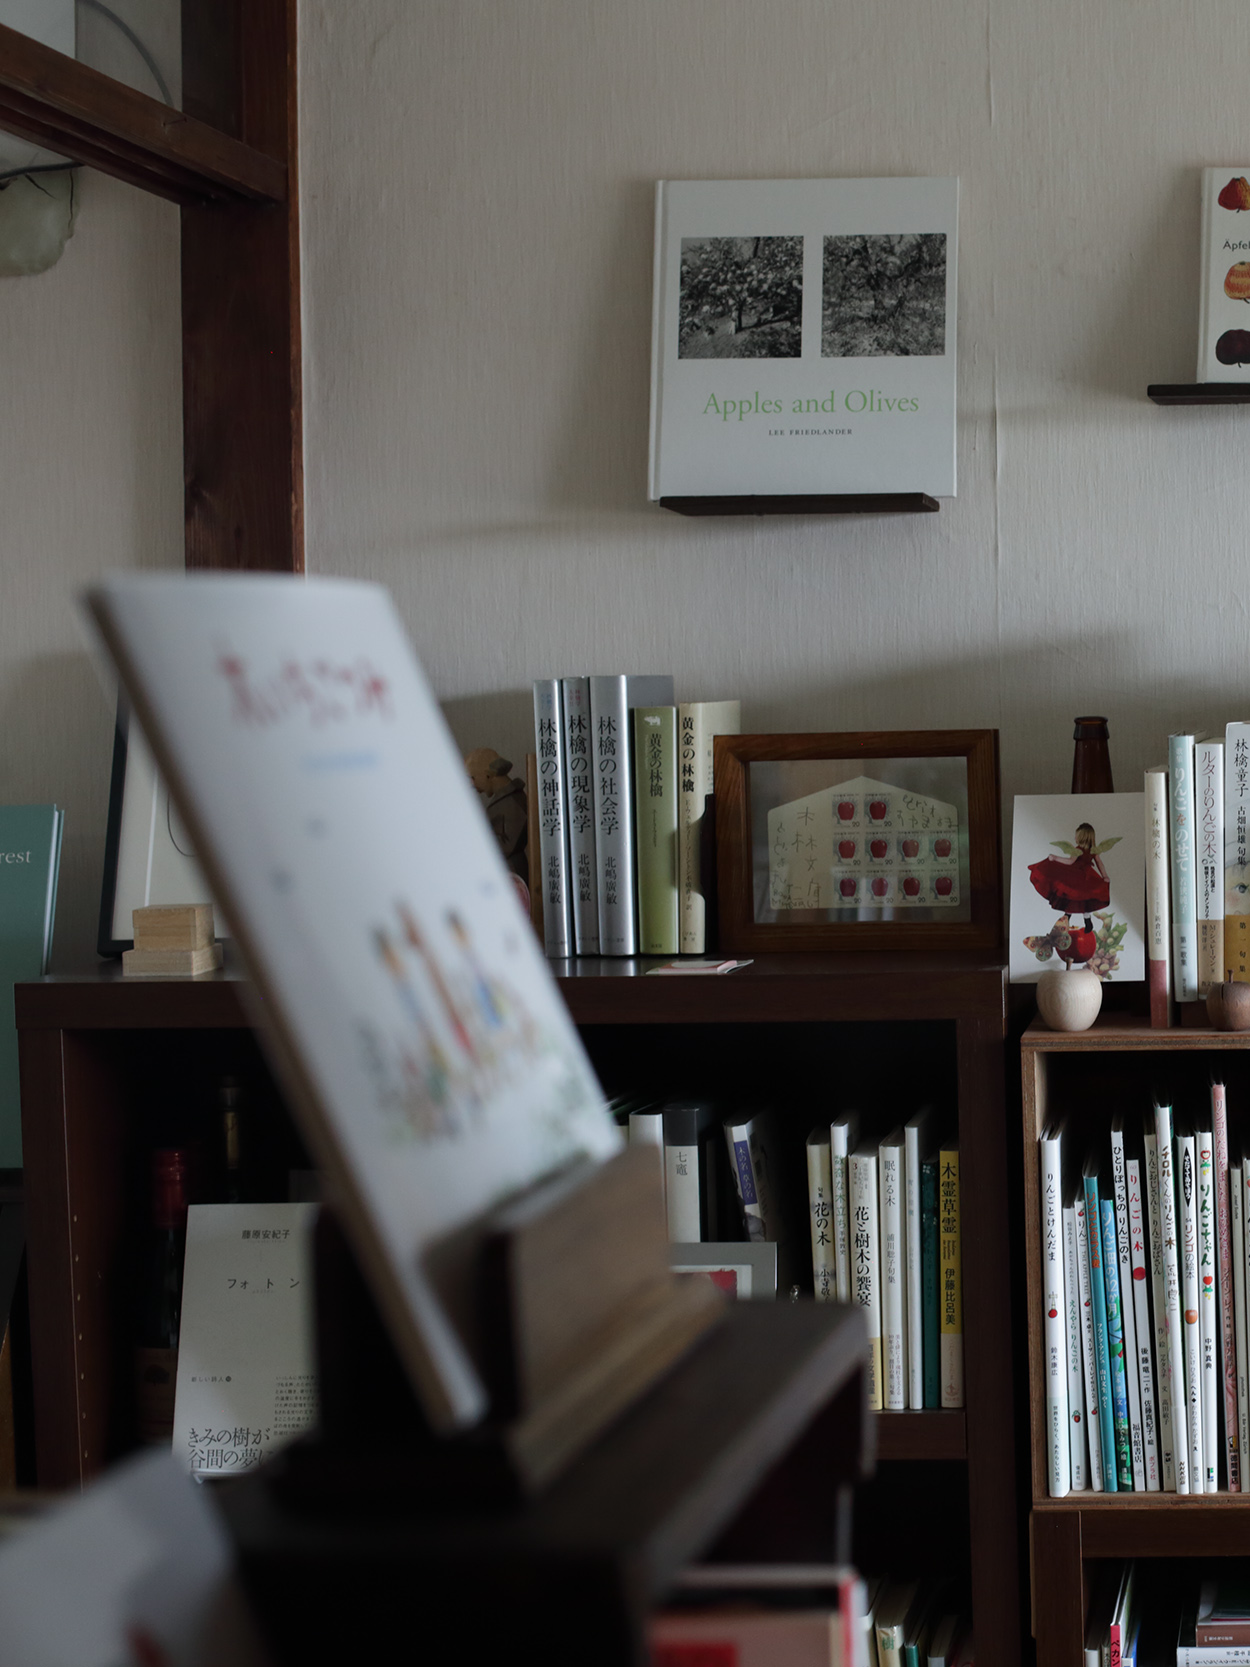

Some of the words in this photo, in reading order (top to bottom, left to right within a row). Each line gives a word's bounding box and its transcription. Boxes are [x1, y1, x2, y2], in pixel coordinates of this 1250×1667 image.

[1223, 239, 1250, 252] Äpfel
[703, 391, 783, 421] Apples
[792, 390, 836, 413] and
[844, 390, 920, 413] Olives
[789, 428, 853, 436] FRIEDLANDER
[538, 717, 561, 837] 林檎の神話学
[568, 714, 591, 834] 林檎の現象学
[597, 716, 619, 836] 林檎の社会学
[648, 732, 664, 799] 黄金の林檎
[681, 716, 696, 793] 黄金の林檎
[1233, 738, 1249, 798] 林檎童子
[1173, 767, 1190, 872] りんごをのせて
[1202, 750, 1217, 854] ルターのりんごの木
[1238, 920, 1247, 974] 第一句集
[884, 1159, 896, 1207] 眠れる木
[941, 1161, 957, 1234] 木霊草霊
[1112, 1146, 1126, 1212] ひとりぼっちの
[1148, 1149, 1158, 1215] りんごおじさんと
[1161, 1146, 1176, 1250] チロルくんのりんごの木
[241, 1229, 291, 1240] 藤原安紀子
[814, 1200, 831, 1246] 花の木
[1045, 1173, 1056, 1261] りんごとけんだま
[1118, 1216, 1130, 1265] りんごのき
[1129, 1174, 1144, 1252] りんごの木
[1200, 1184, 1214, 1267] りんごちゃん
[1152, 1219, 1162, 1276] りんごおばさん
[1184, 1224, 1195, 1279] リンゴの絵本
[944, 1268, 956, 1326] 伊藤比呂美
[1069, 1299, 1078, 1331] えんやら
[1070, 1333, 1079, 1373] りんごの木
[187, 1427, 271, 1449] きみの樹が
